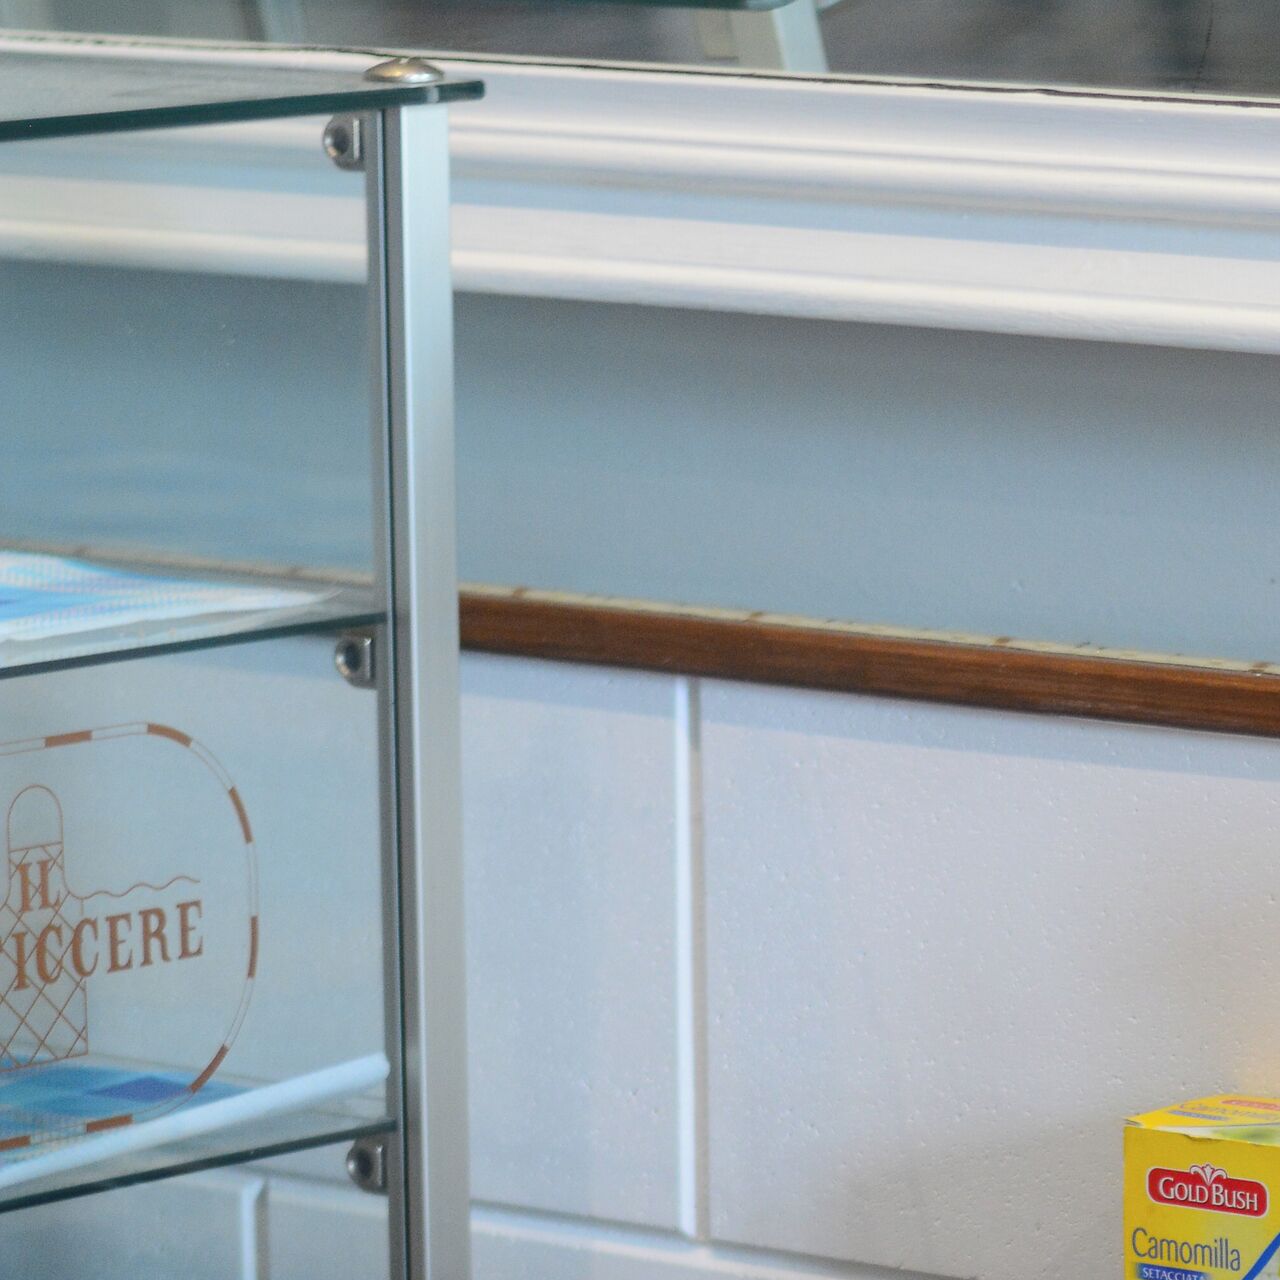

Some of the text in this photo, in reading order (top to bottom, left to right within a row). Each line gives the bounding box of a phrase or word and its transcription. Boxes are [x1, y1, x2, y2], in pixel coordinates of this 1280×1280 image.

[0, 899, 203, 992] ICCERE
[1160, 1177, 1258, 1211] GOLD BUSH
[1132, 1227, 1240, 1272] Camomilla
